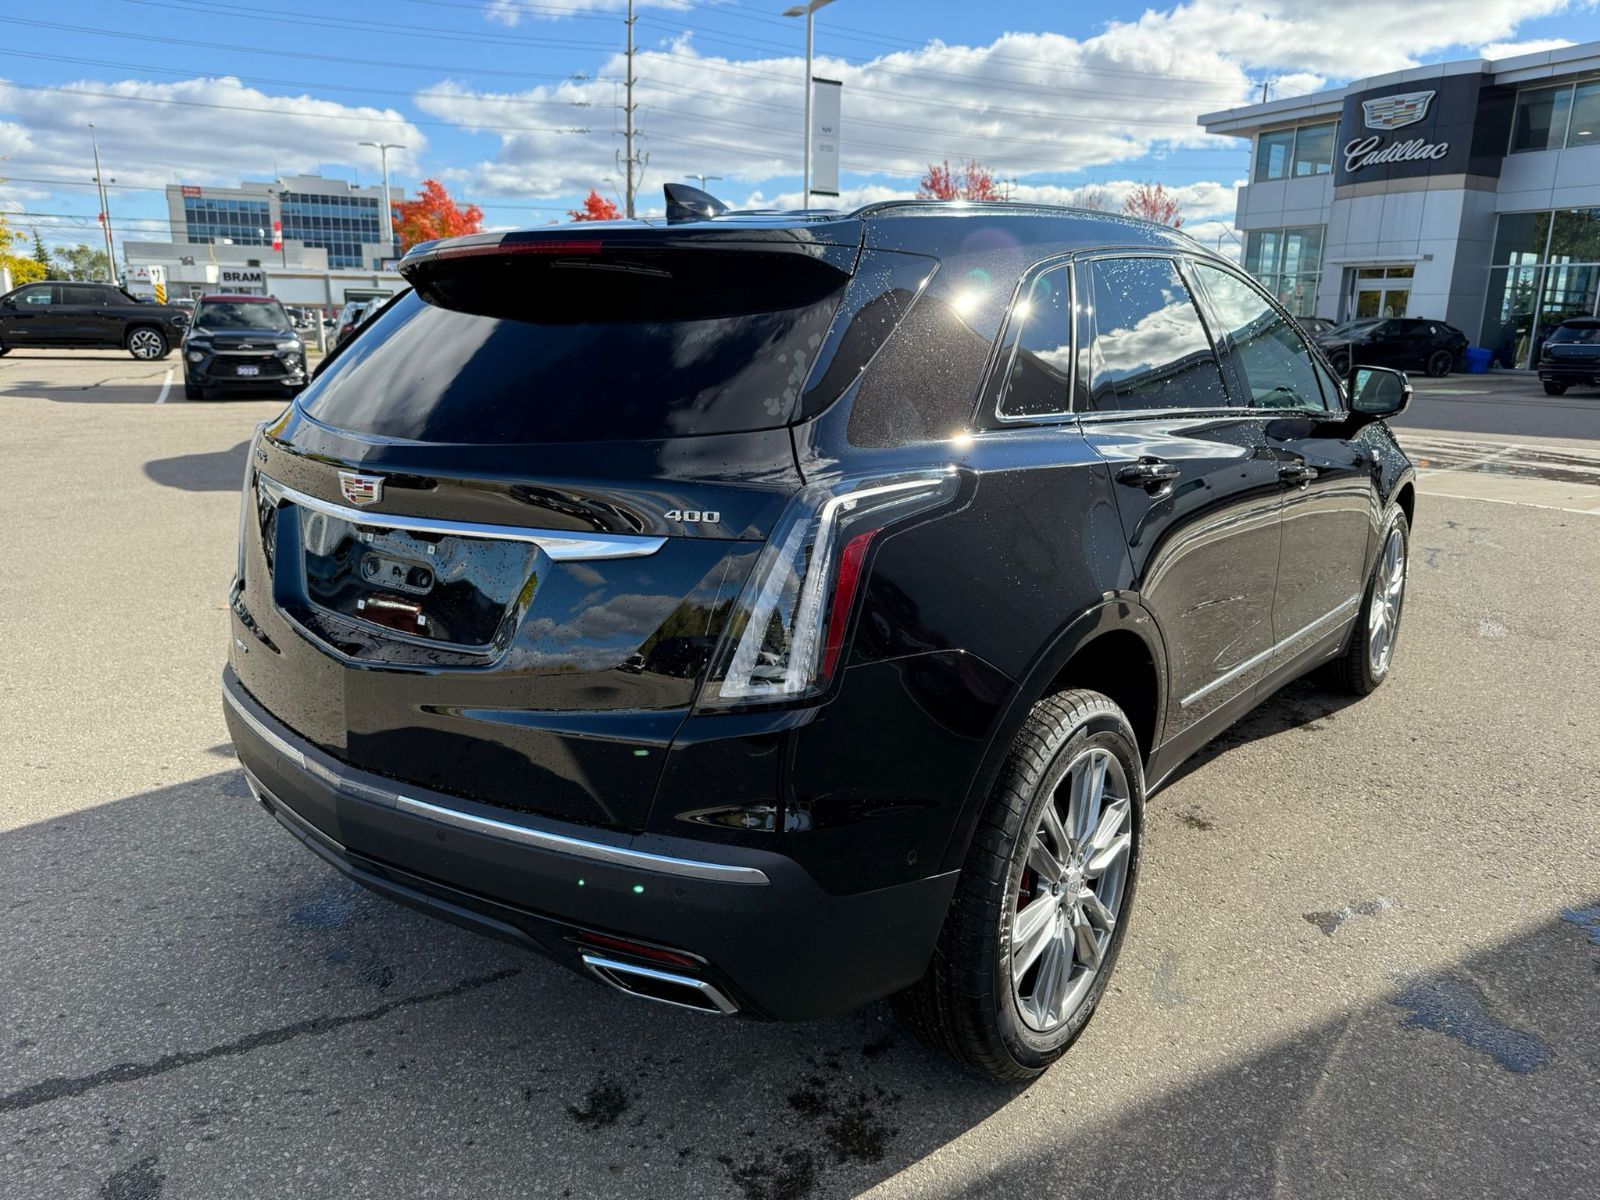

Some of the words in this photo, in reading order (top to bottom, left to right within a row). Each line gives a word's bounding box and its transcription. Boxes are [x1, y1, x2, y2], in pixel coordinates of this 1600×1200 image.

[1344, 136, 1449, 172] Cadillac
[223, 272, 261, 281] BRAM
[663, 509, 720, 522] 400
